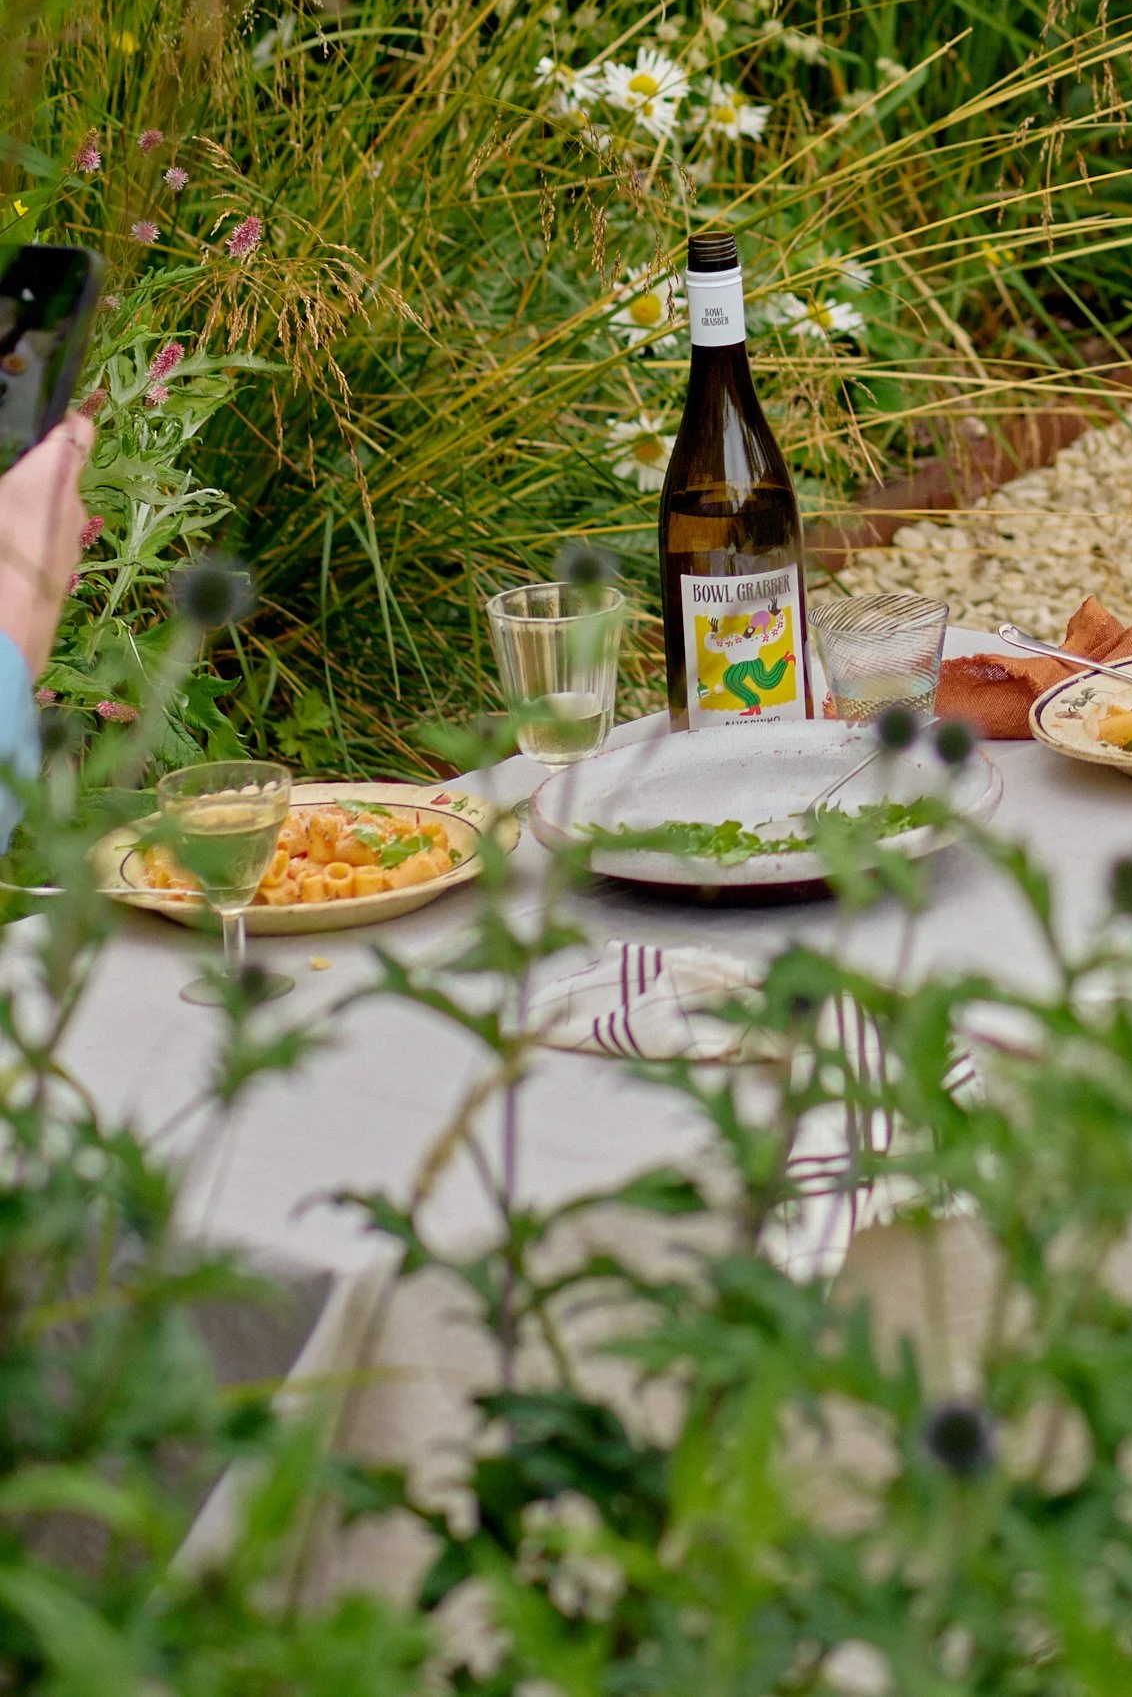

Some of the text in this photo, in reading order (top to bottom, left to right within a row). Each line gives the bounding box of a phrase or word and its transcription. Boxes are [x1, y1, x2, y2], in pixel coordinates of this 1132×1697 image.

[705, 307, 724, 316] BOWL
[693, 574, 791, 603] BOWL GRABBER
